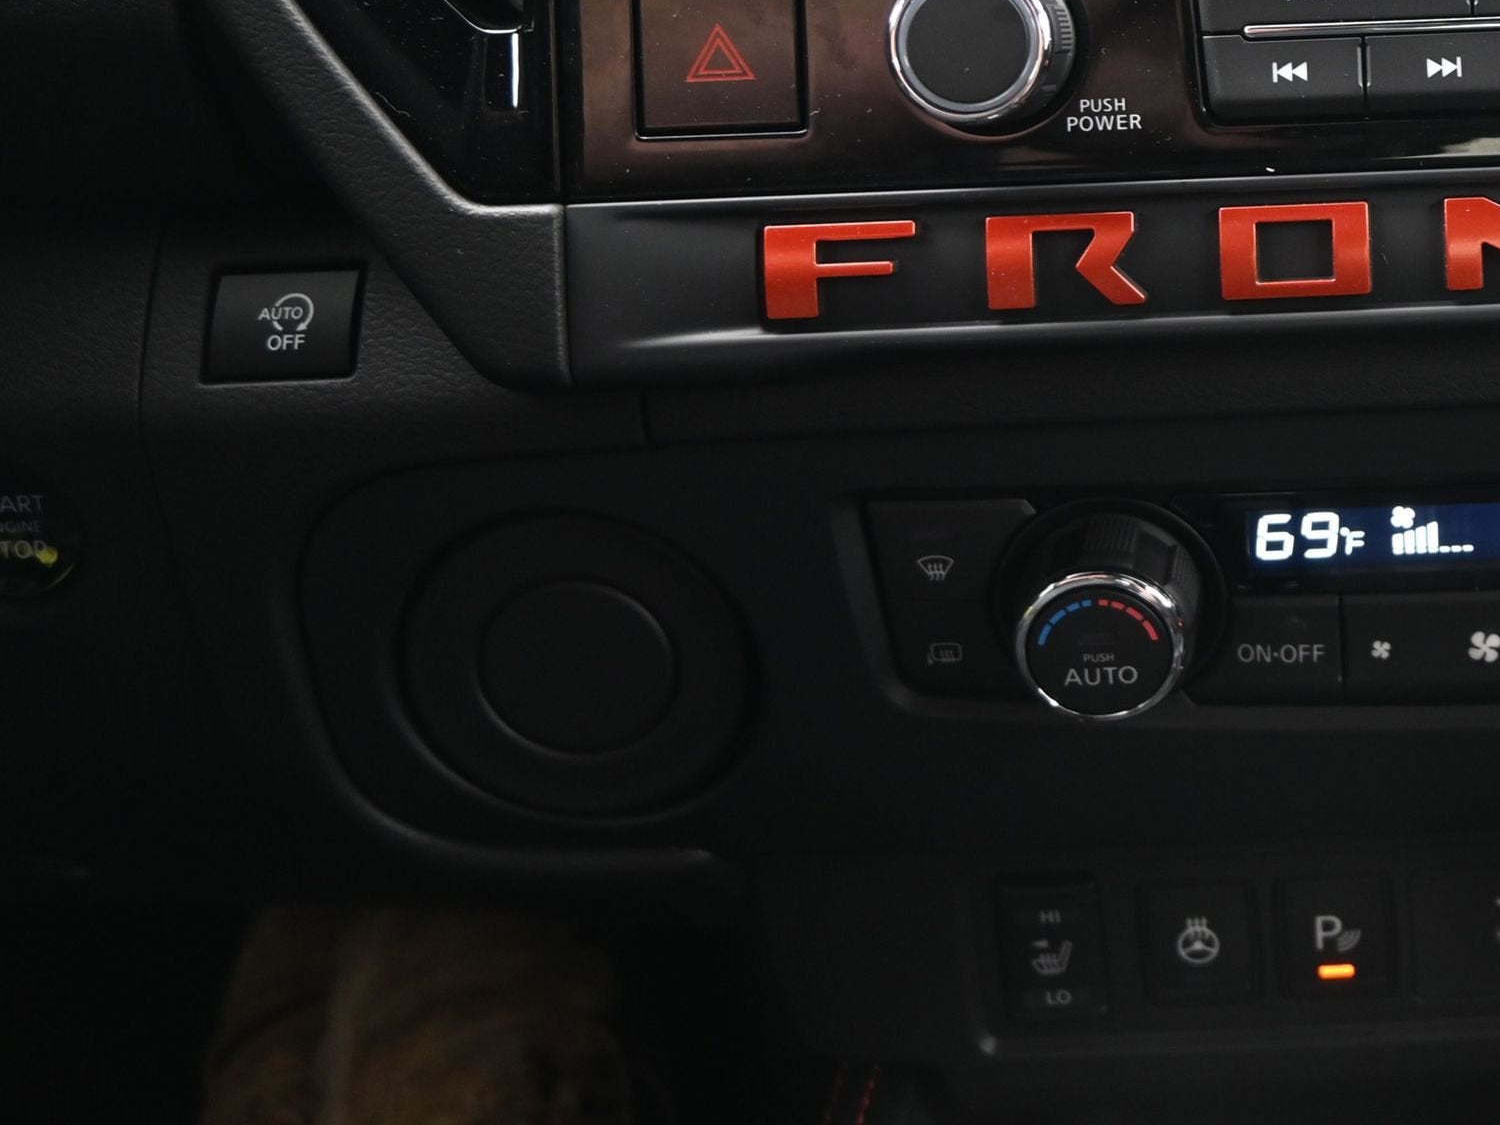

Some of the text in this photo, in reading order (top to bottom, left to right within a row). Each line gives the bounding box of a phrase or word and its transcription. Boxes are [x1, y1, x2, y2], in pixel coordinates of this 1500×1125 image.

[1079, 98, 1127, 114] PUSH
[1066, 114, 1143, 133] POWER
[258, 306, 304, 321] AUTO
[267, 333, 307, 352] OFF
[1082, 651, 1116, 663] PUSH
[1063, 666, 1139, 687] AUTO
[1039, 910, 1061, 924] HI
[1045, 990, 1073, 1006] LO
